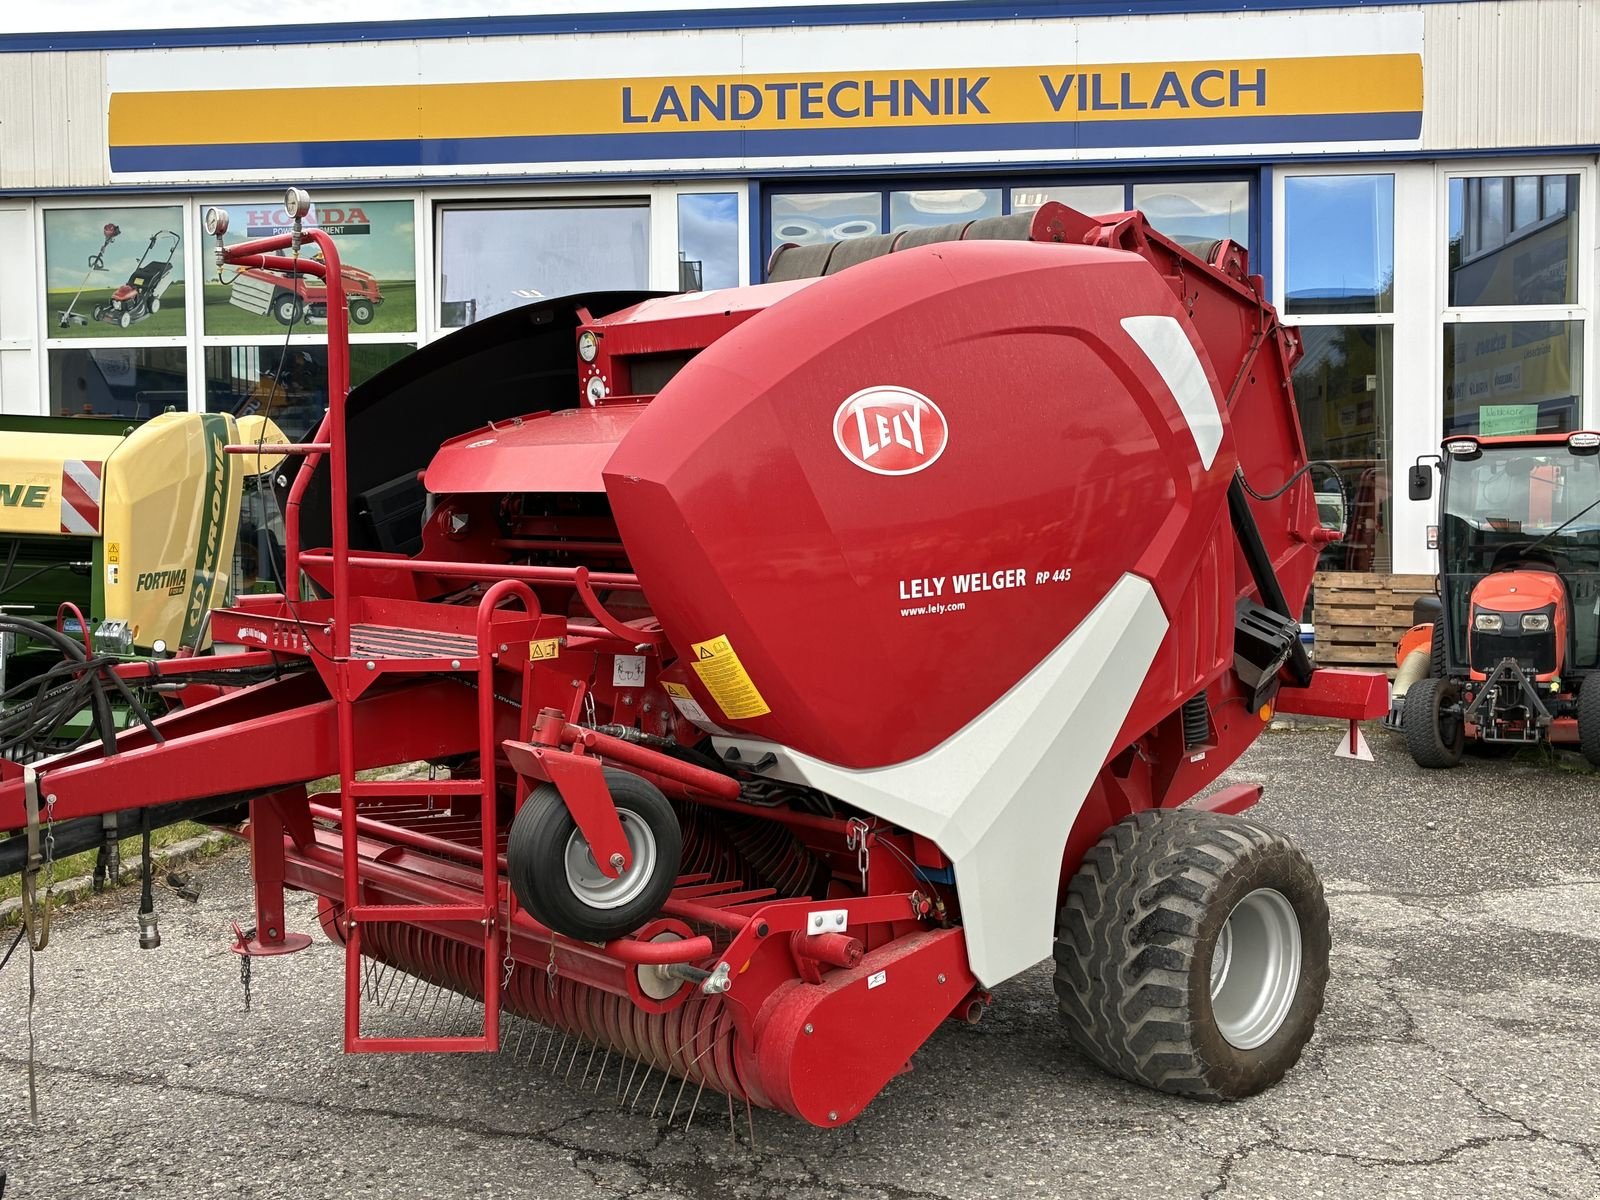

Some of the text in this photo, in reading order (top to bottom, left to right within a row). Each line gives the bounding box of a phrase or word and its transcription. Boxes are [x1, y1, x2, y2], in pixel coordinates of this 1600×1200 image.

[620, 68, 1267, 124] LANDTECHNIK VILLACH
[854, 399, 924, 461] LELY
[203, 432, 224, 581] KRONE
[136, 569, 187, 592] FORTIMA
[899, 568, 1072, 600] LELY WELGER RP 445
[900, 602, 966, 617] www.lely.com
